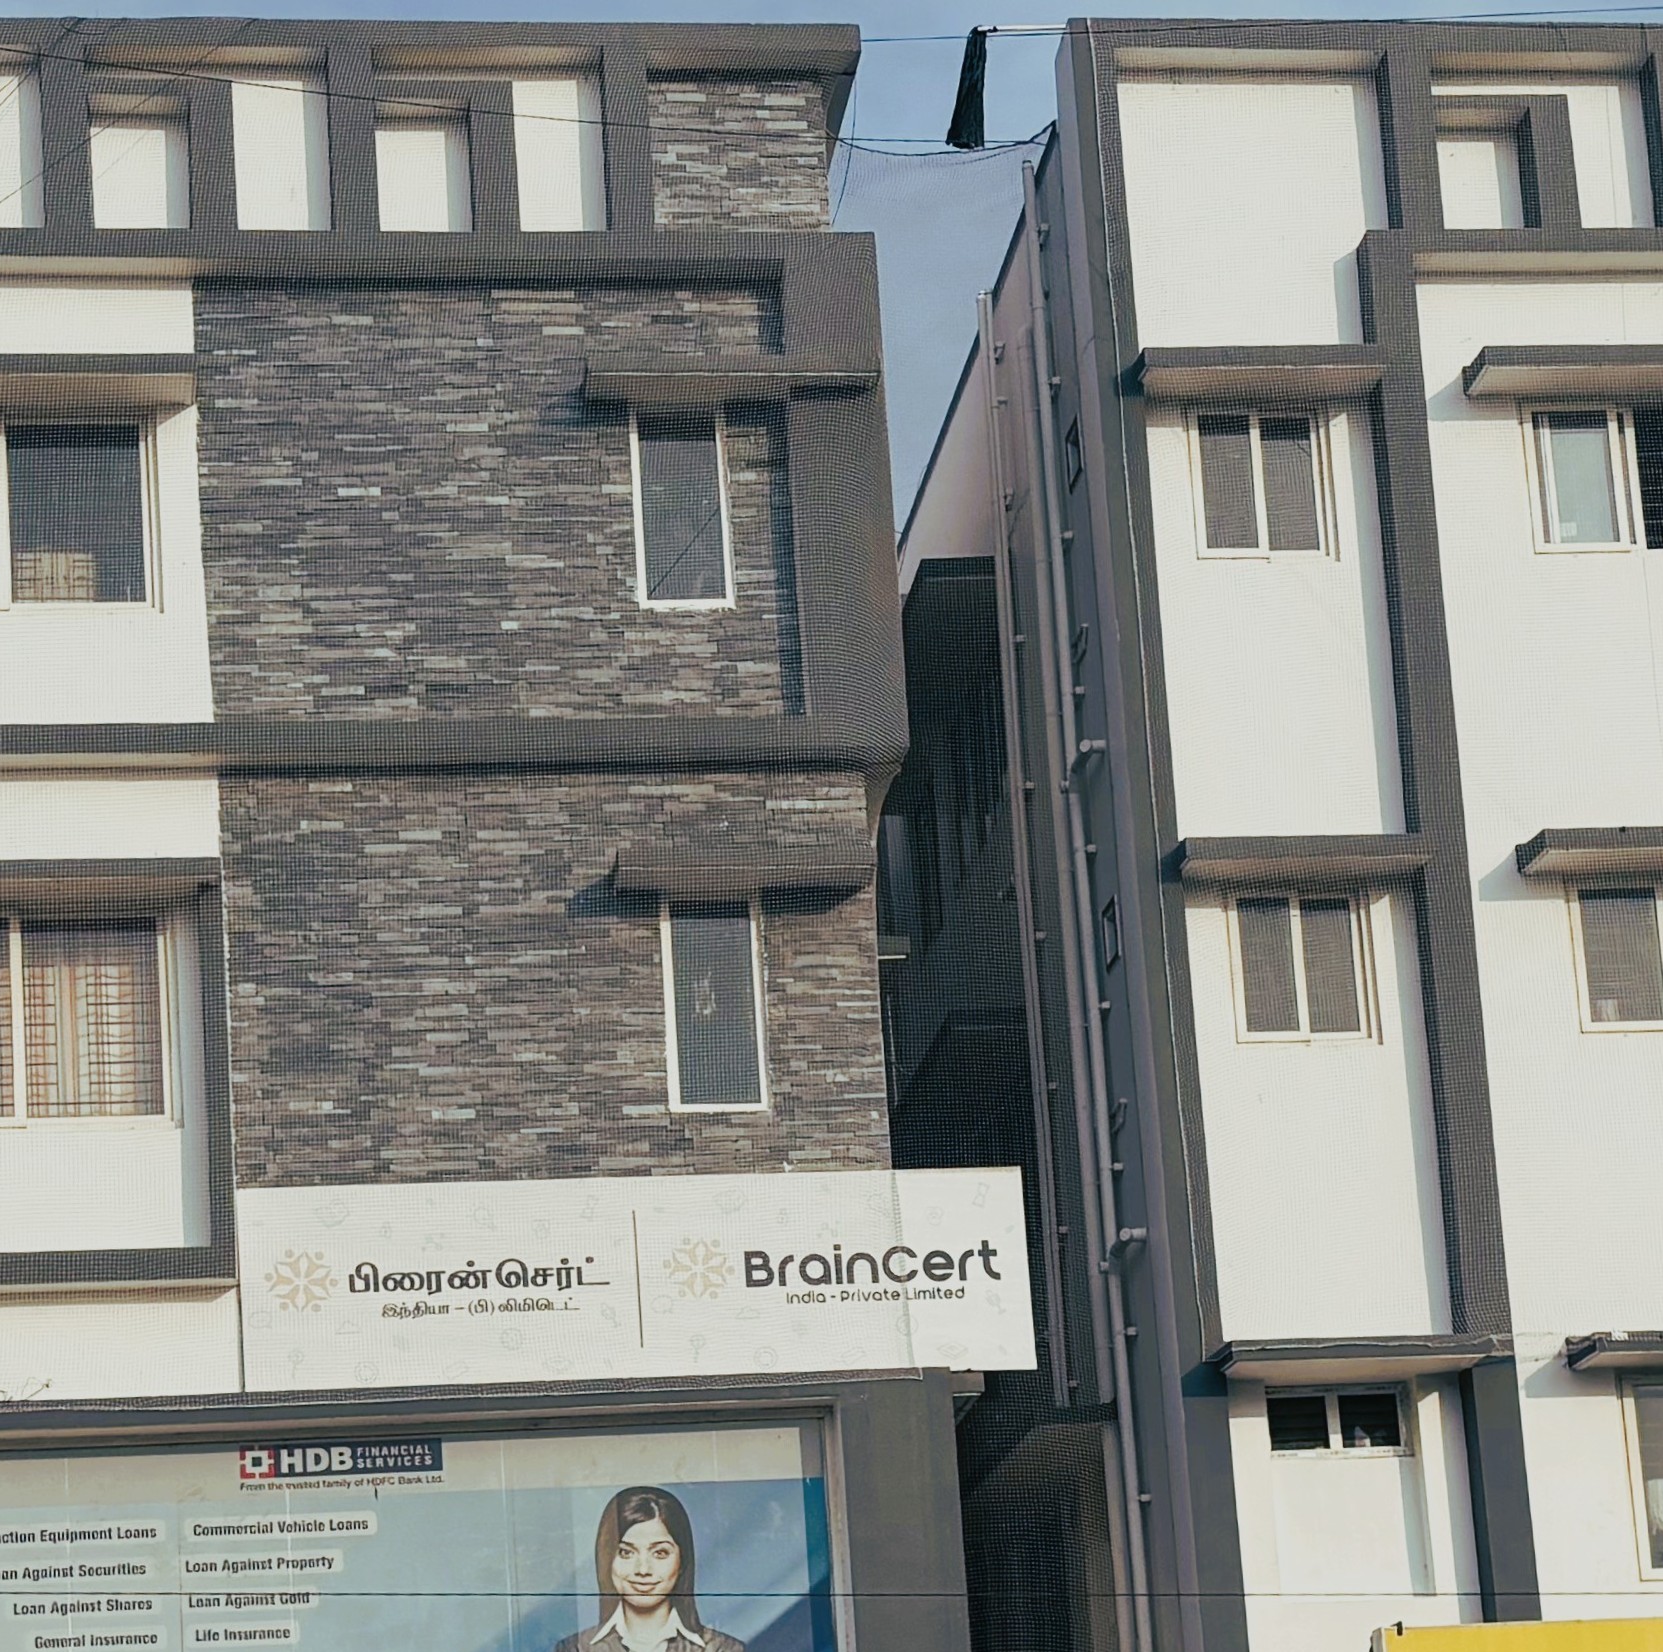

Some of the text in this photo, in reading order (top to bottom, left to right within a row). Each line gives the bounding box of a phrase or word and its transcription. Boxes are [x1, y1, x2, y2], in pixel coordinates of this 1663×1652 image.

[743, 1239, 1002, 1288] BrainCert
[786, 1286, 966, 1305] India Private Limited
[280, 1444, 432, 1474] HDB FINANCIAL
[356, 1456, 433, 1469] SERVICES
[267, 1481, 284, 1490] the
[354, 1477, 365, 1486] of
[39, 1526, 113, 1545] Equipment
[116, 1525, 157, 1541] Loans
[192, 1517, 369, 1538] Commercial Vehicle Loans
[22, 1564, 75, 1582] Against
[78, 1562, 147, 1578] Securities
[185, 1554, 335, 1575] Loan Against Property
[13, 1597, 153, 1617] Loan Against Shares
[188, 1594, 222, 1609] Loan
[225, 1591, 276, 1610] Against
[34, 1631, 158, 1650] General Insurance
[195, 1625, 292, 1642] Life Insurance
